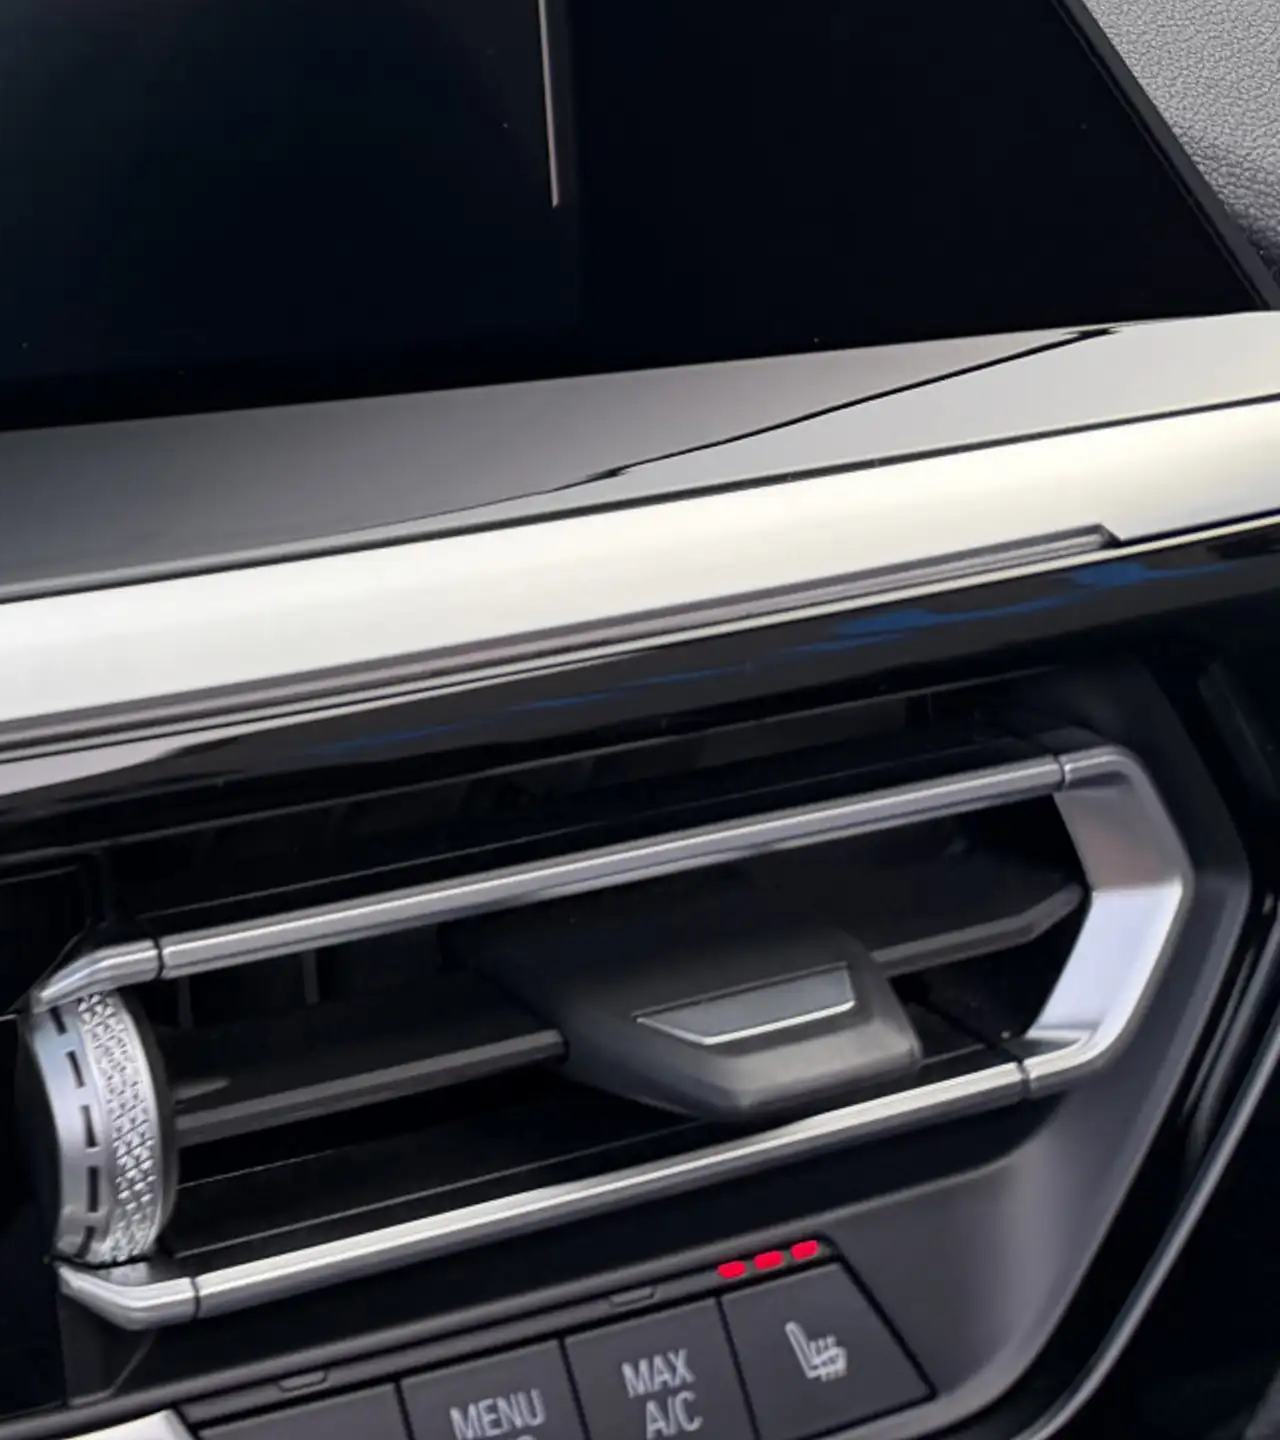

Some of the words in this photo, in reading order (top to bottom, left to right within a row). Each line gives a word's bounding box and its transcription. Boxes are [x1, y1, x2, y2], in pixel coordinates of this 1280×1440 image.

[621, 1348, 696, 1399] MAX
[449, 1388, 546, 1440] MENU
[643, 1390, 703, 1439] A/C
